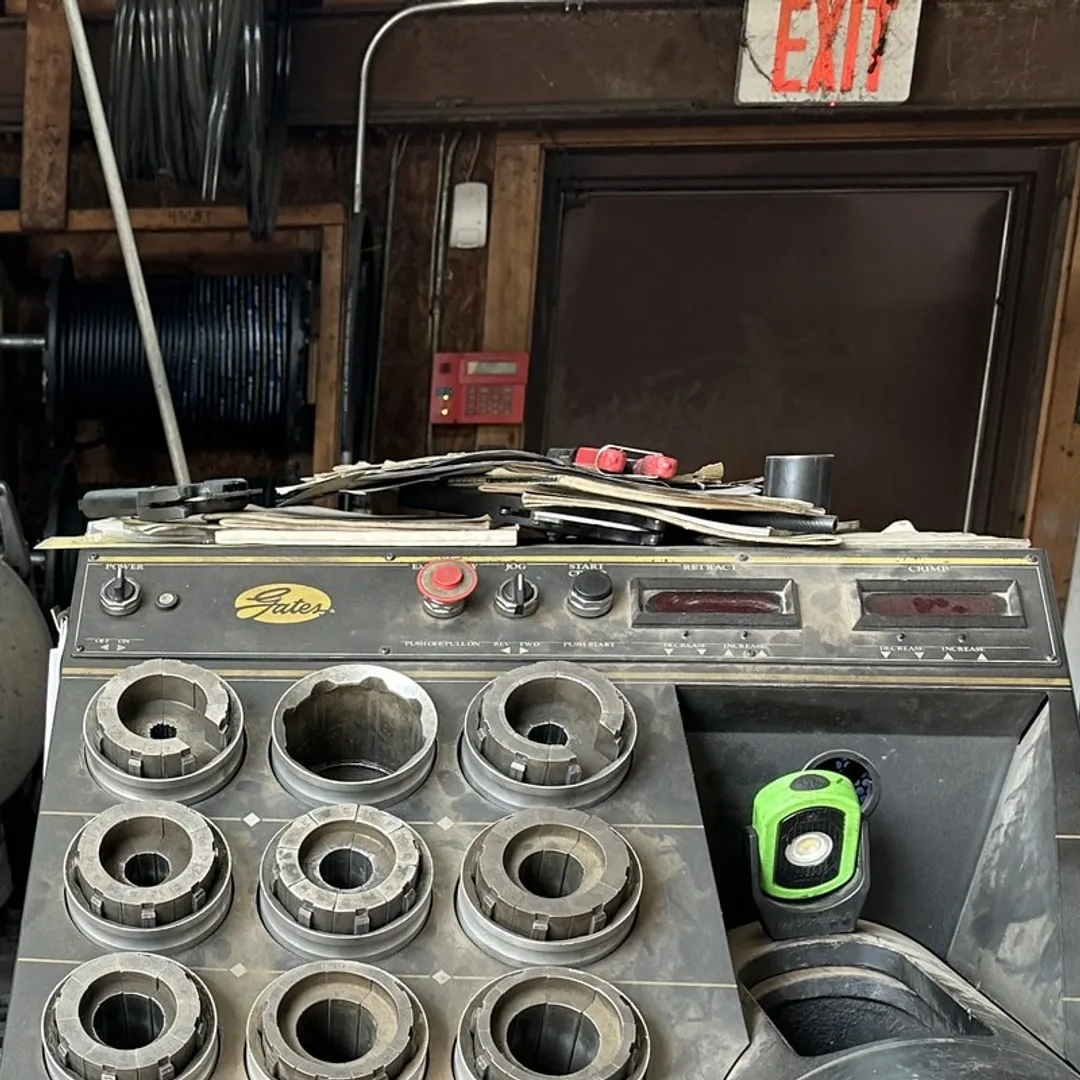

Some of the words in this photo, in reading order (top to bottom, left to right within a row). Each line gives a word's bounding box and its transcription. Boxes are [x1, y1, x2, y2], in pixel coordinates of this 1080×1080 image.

[771, 0, 898, 93] EXIT
[504, 563, 527, 571] JOG
[908, 565, 950, 573] CRIMP
[236, 587, 324, 621] Gates
